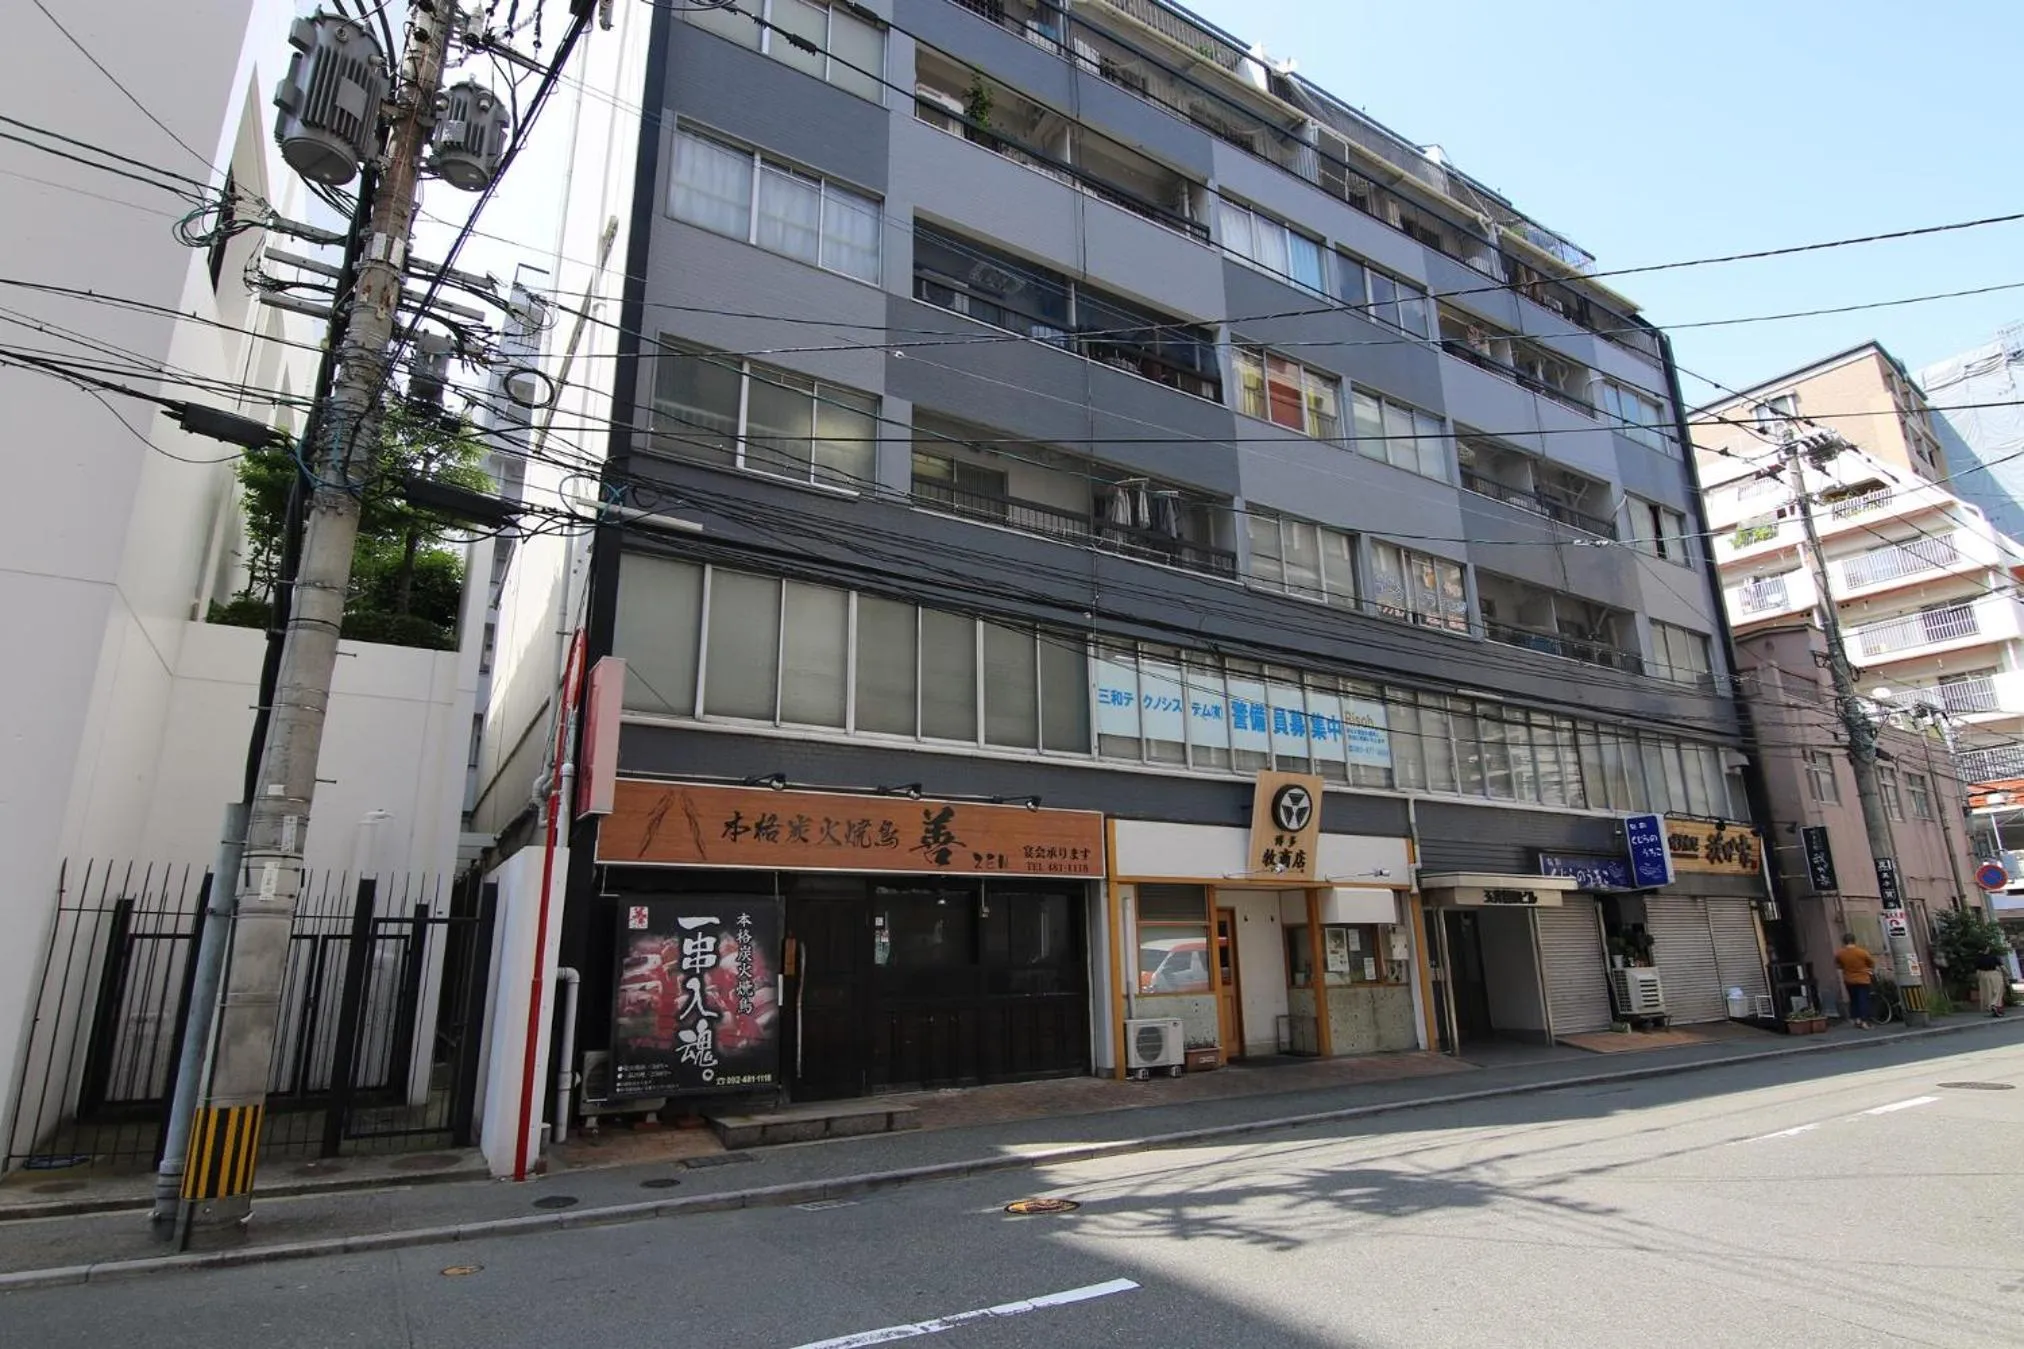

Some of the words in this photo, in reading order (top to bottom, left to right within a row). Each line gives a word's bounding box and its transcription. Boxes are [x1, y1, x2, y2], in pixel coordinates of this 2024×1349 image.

[721, 811, 898, 849] 本格炭火焼鳥
[736, 913, 753, 1014] 本格炭火焼鳥
